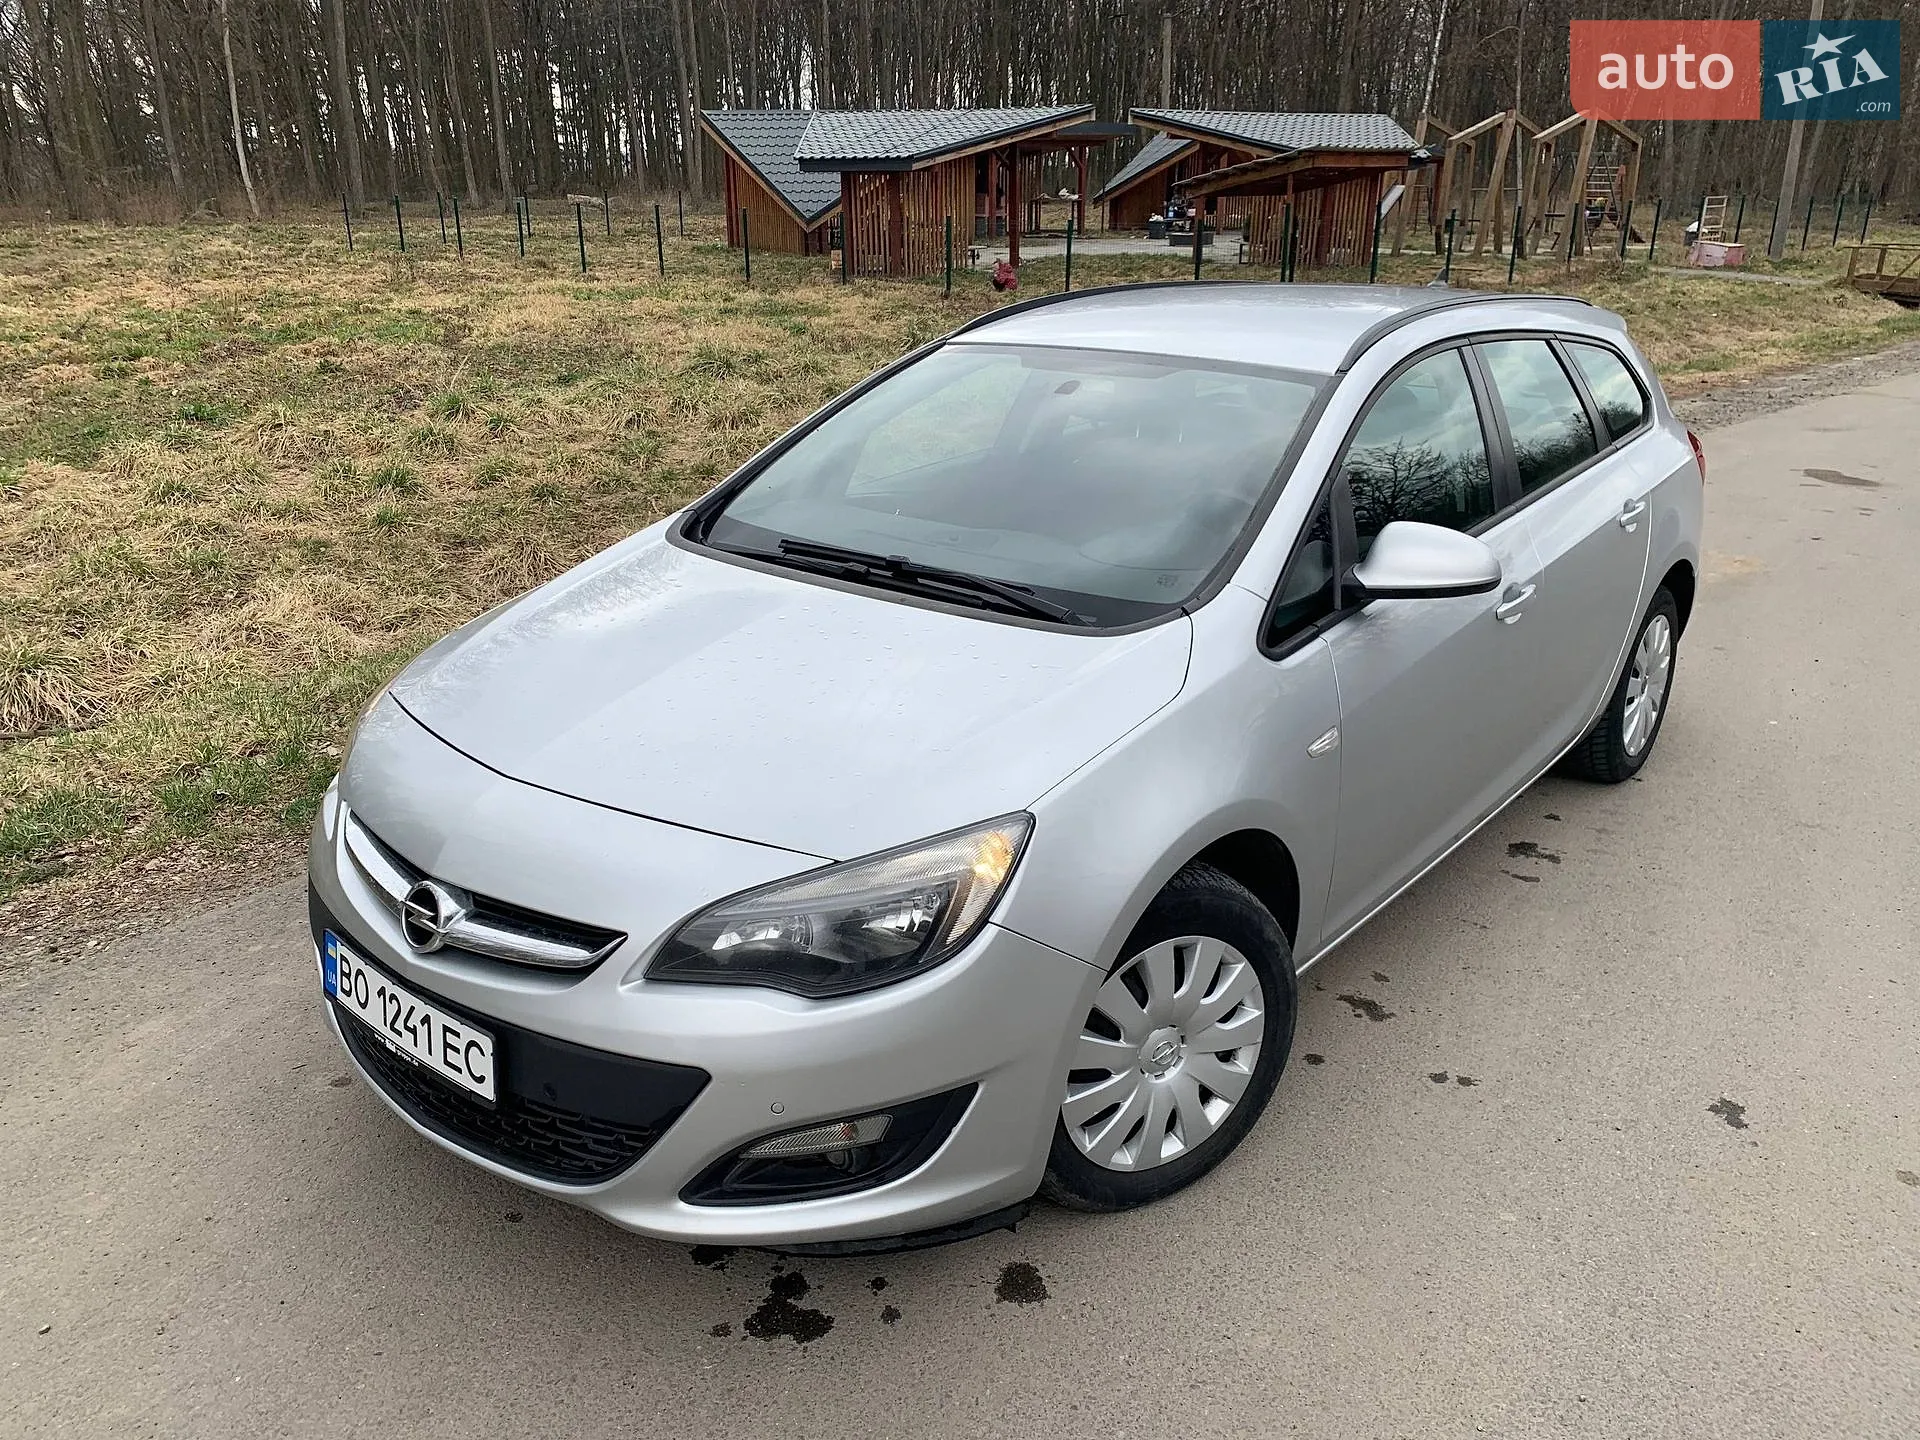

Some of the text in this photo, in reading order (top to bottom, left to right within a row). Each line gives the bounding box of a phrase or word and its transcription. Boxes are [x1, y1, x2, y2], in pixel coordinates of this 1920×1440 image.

[327, 970, 337, 986] UA
[339, 952, 370, 1010] BO
[377, 985, 433, 1057] 1241
[442, 1023, 486, 1085] EC
